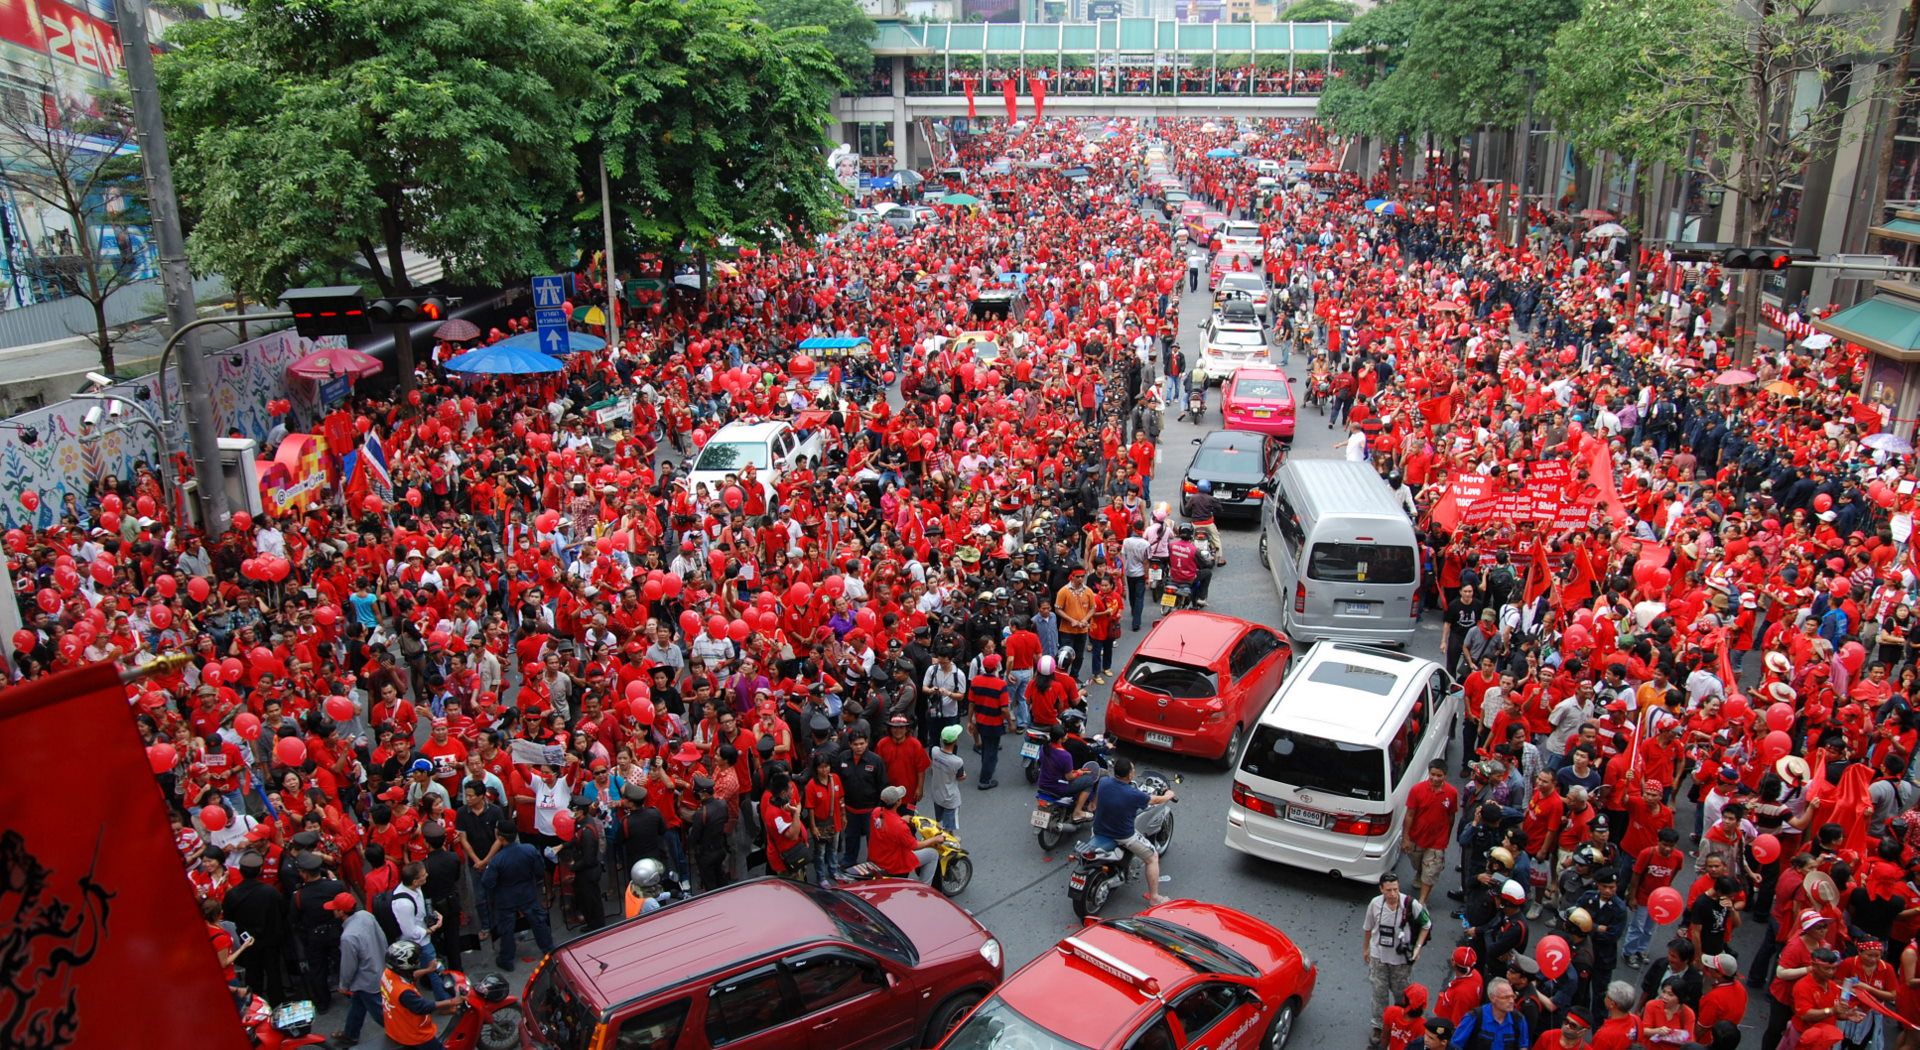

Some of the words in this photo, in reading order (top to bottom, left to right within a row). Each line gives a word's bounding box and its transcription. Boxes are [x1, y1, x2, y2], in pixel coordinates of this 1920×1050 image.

[42, 14, 119, 78] ZEN
[1459, 474, 1485, 483] Here
[1464, 486, 1481, 496] Love
[1538, 501, 1557, 511] Shirt
